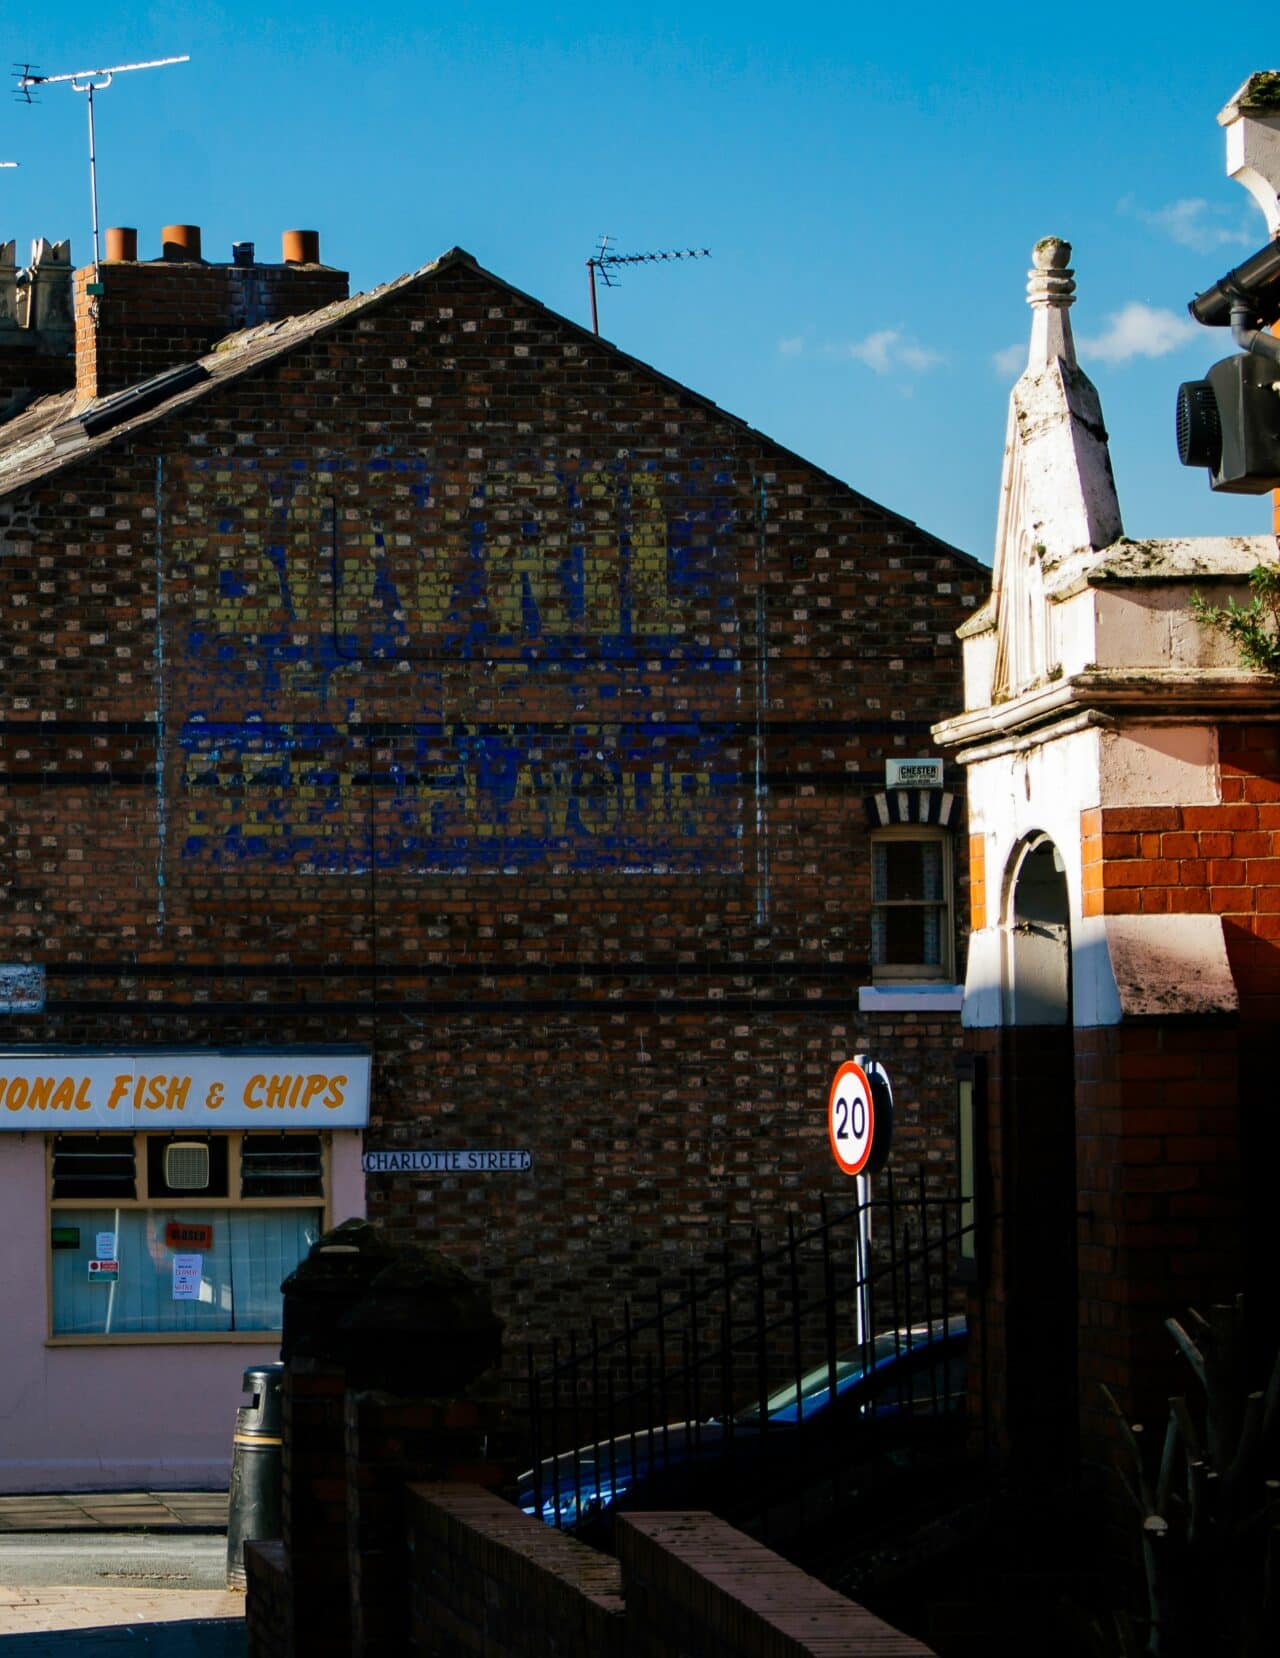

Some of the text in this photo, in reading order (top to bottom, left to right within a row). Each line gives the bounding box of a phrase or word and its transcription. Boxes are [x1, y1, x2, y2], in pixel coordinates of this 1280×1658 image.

[108, 1075, 191, 1110] FISH
[206, 1084, 224, 1109] &
[244, 1075, 347, 1109] CHIPS
[835, 1097, 865, 1139] 20
[366, 1152, 525, 1170] CHARLOTTE STREET
[171, 1229, 206, 1241] CLOSED
